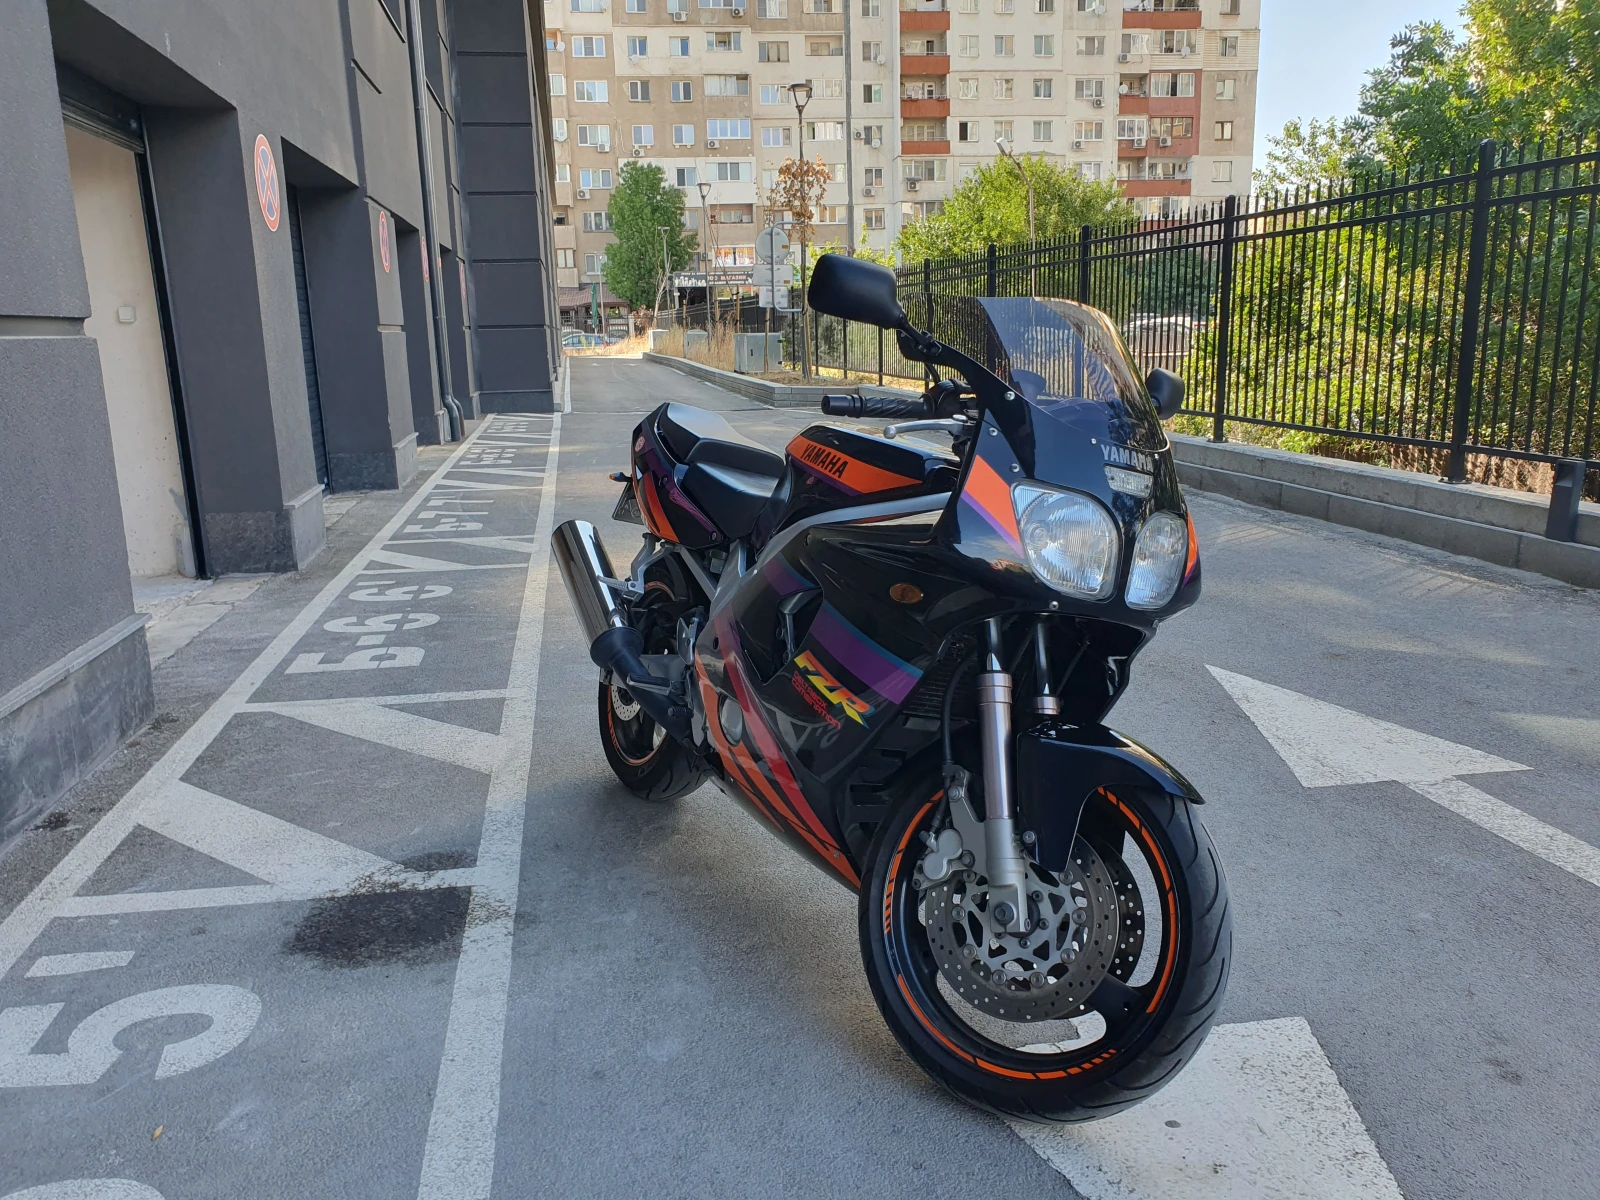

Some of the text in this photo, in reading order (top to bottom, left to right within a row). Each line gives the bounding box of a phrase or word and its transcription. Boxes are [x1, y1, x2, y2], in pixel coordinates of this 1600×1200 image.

[800, 443, 849, 479] YAMAHA
[1100, 444, 1153, 473] YAMAHA
[791, 679, 841, 729] COMBINATION
[793, 671, 827, 710] DELTABOX
[794, 650, 872, 726] FZR
